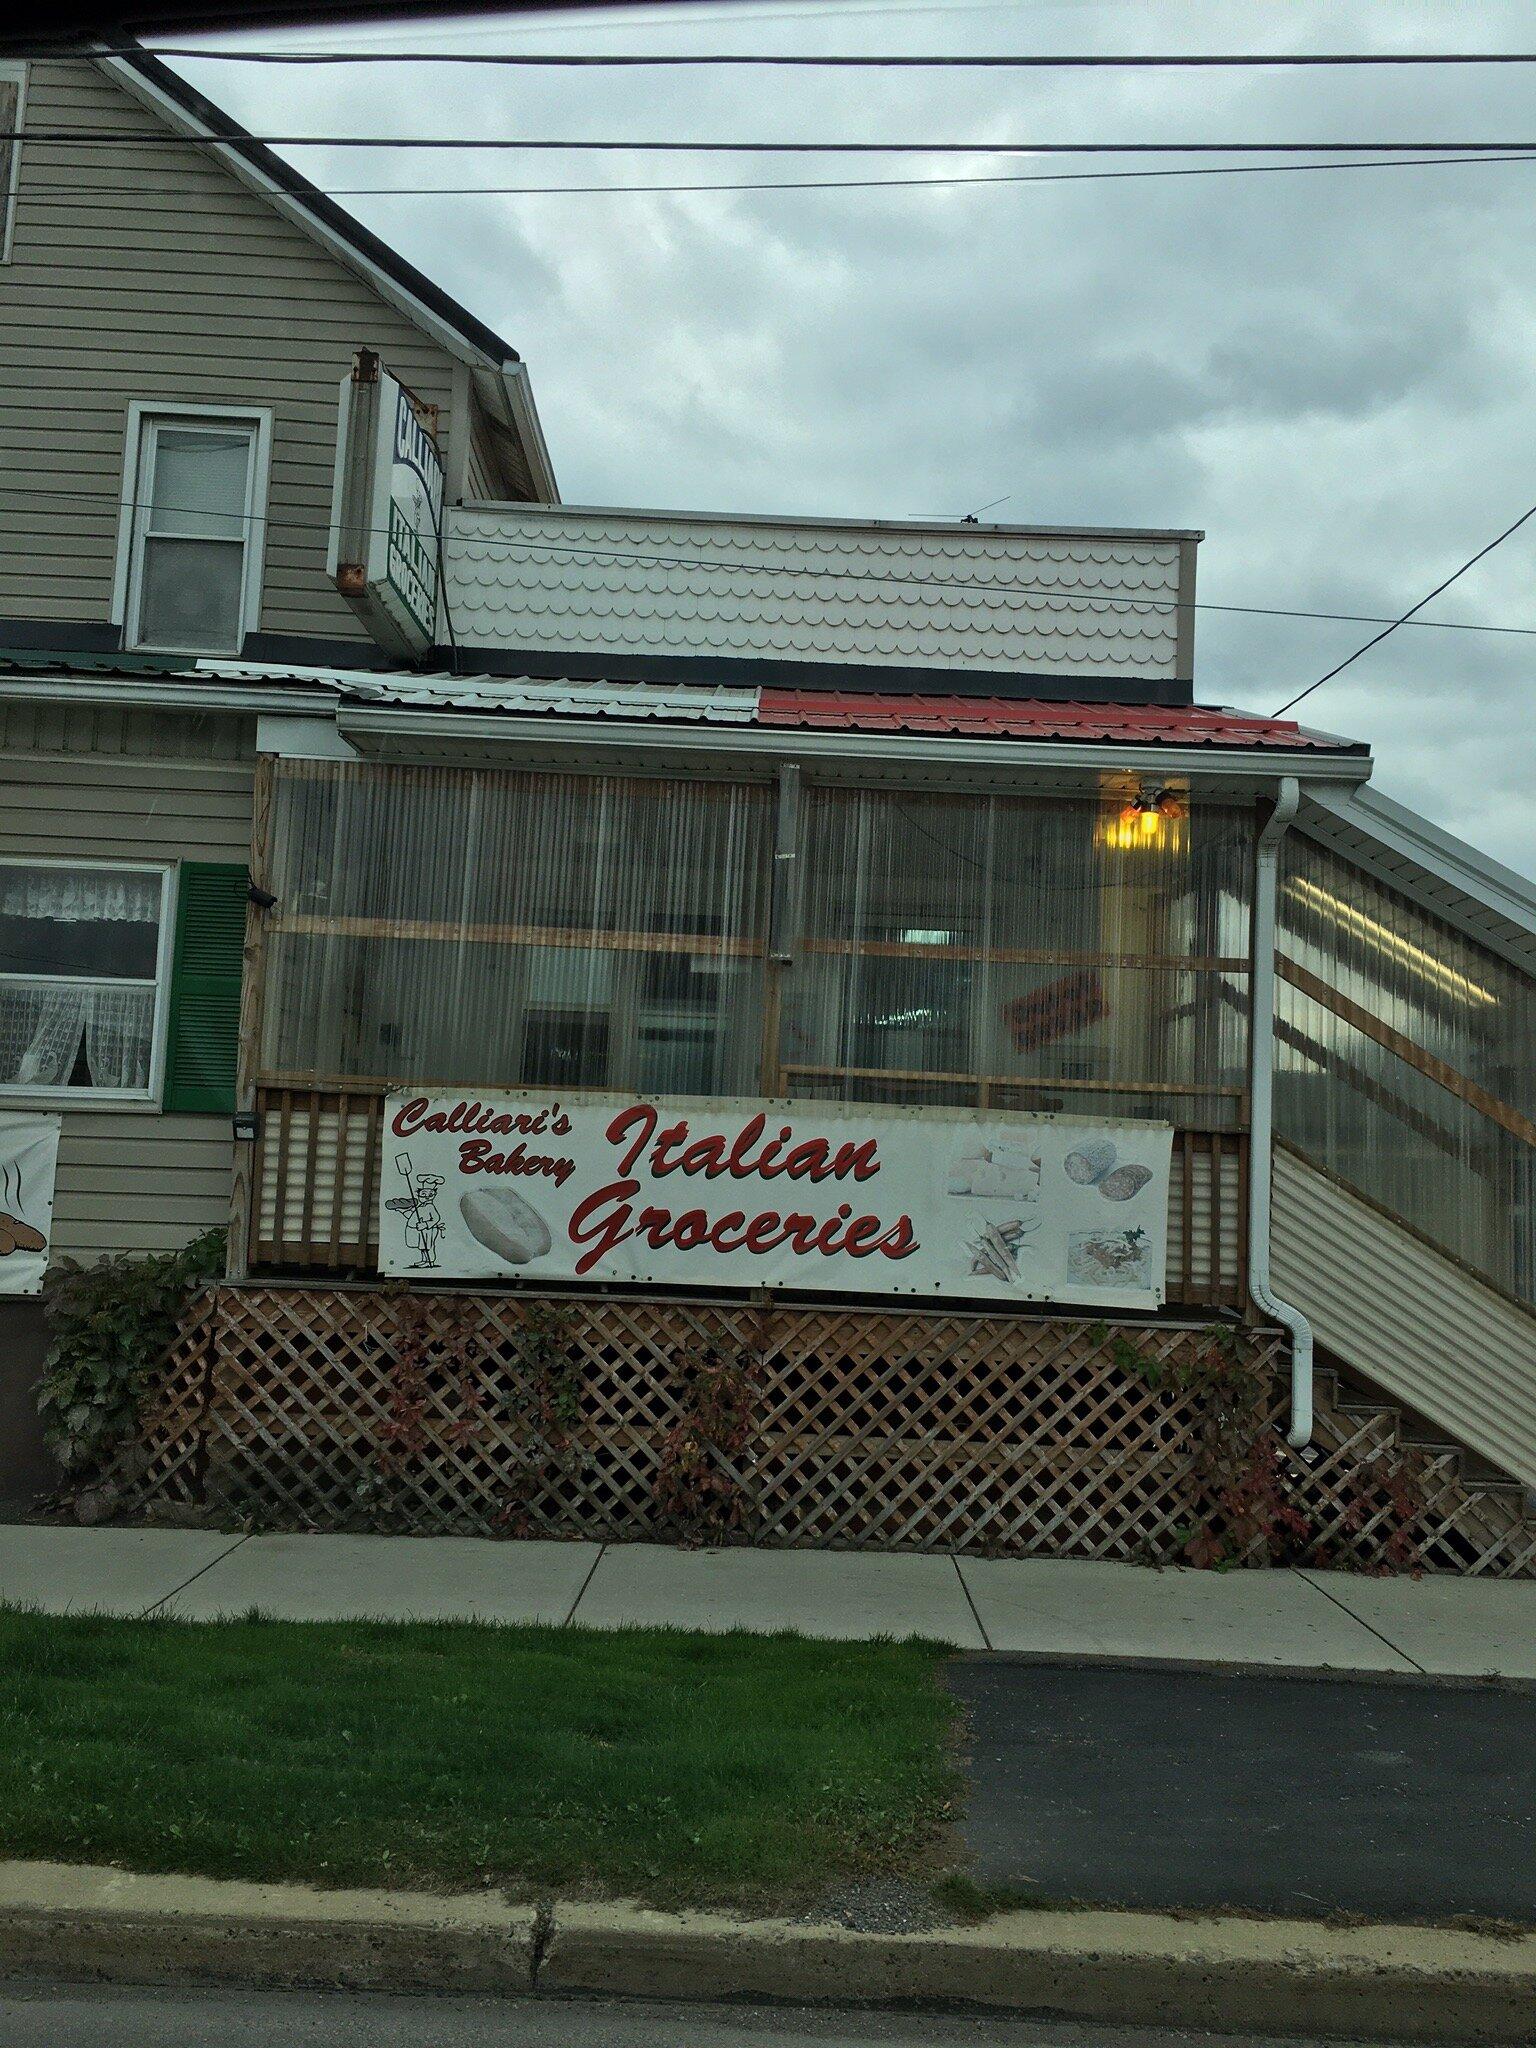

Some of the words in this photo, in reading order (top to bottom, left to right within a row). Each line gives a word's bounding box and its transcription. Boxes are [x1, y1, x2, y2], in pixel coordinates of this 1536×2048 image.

[390, 543, 435, 638] GROCERIES
[392, 504, 436, 602] ITALIAN
[392, 1097, 572, 1137] Calliari's
[605, 1104, 880, 1182] Italian
[459, 1139, 576, 1188] Bakery
[568, 1180, 921, 1275] Groceries
